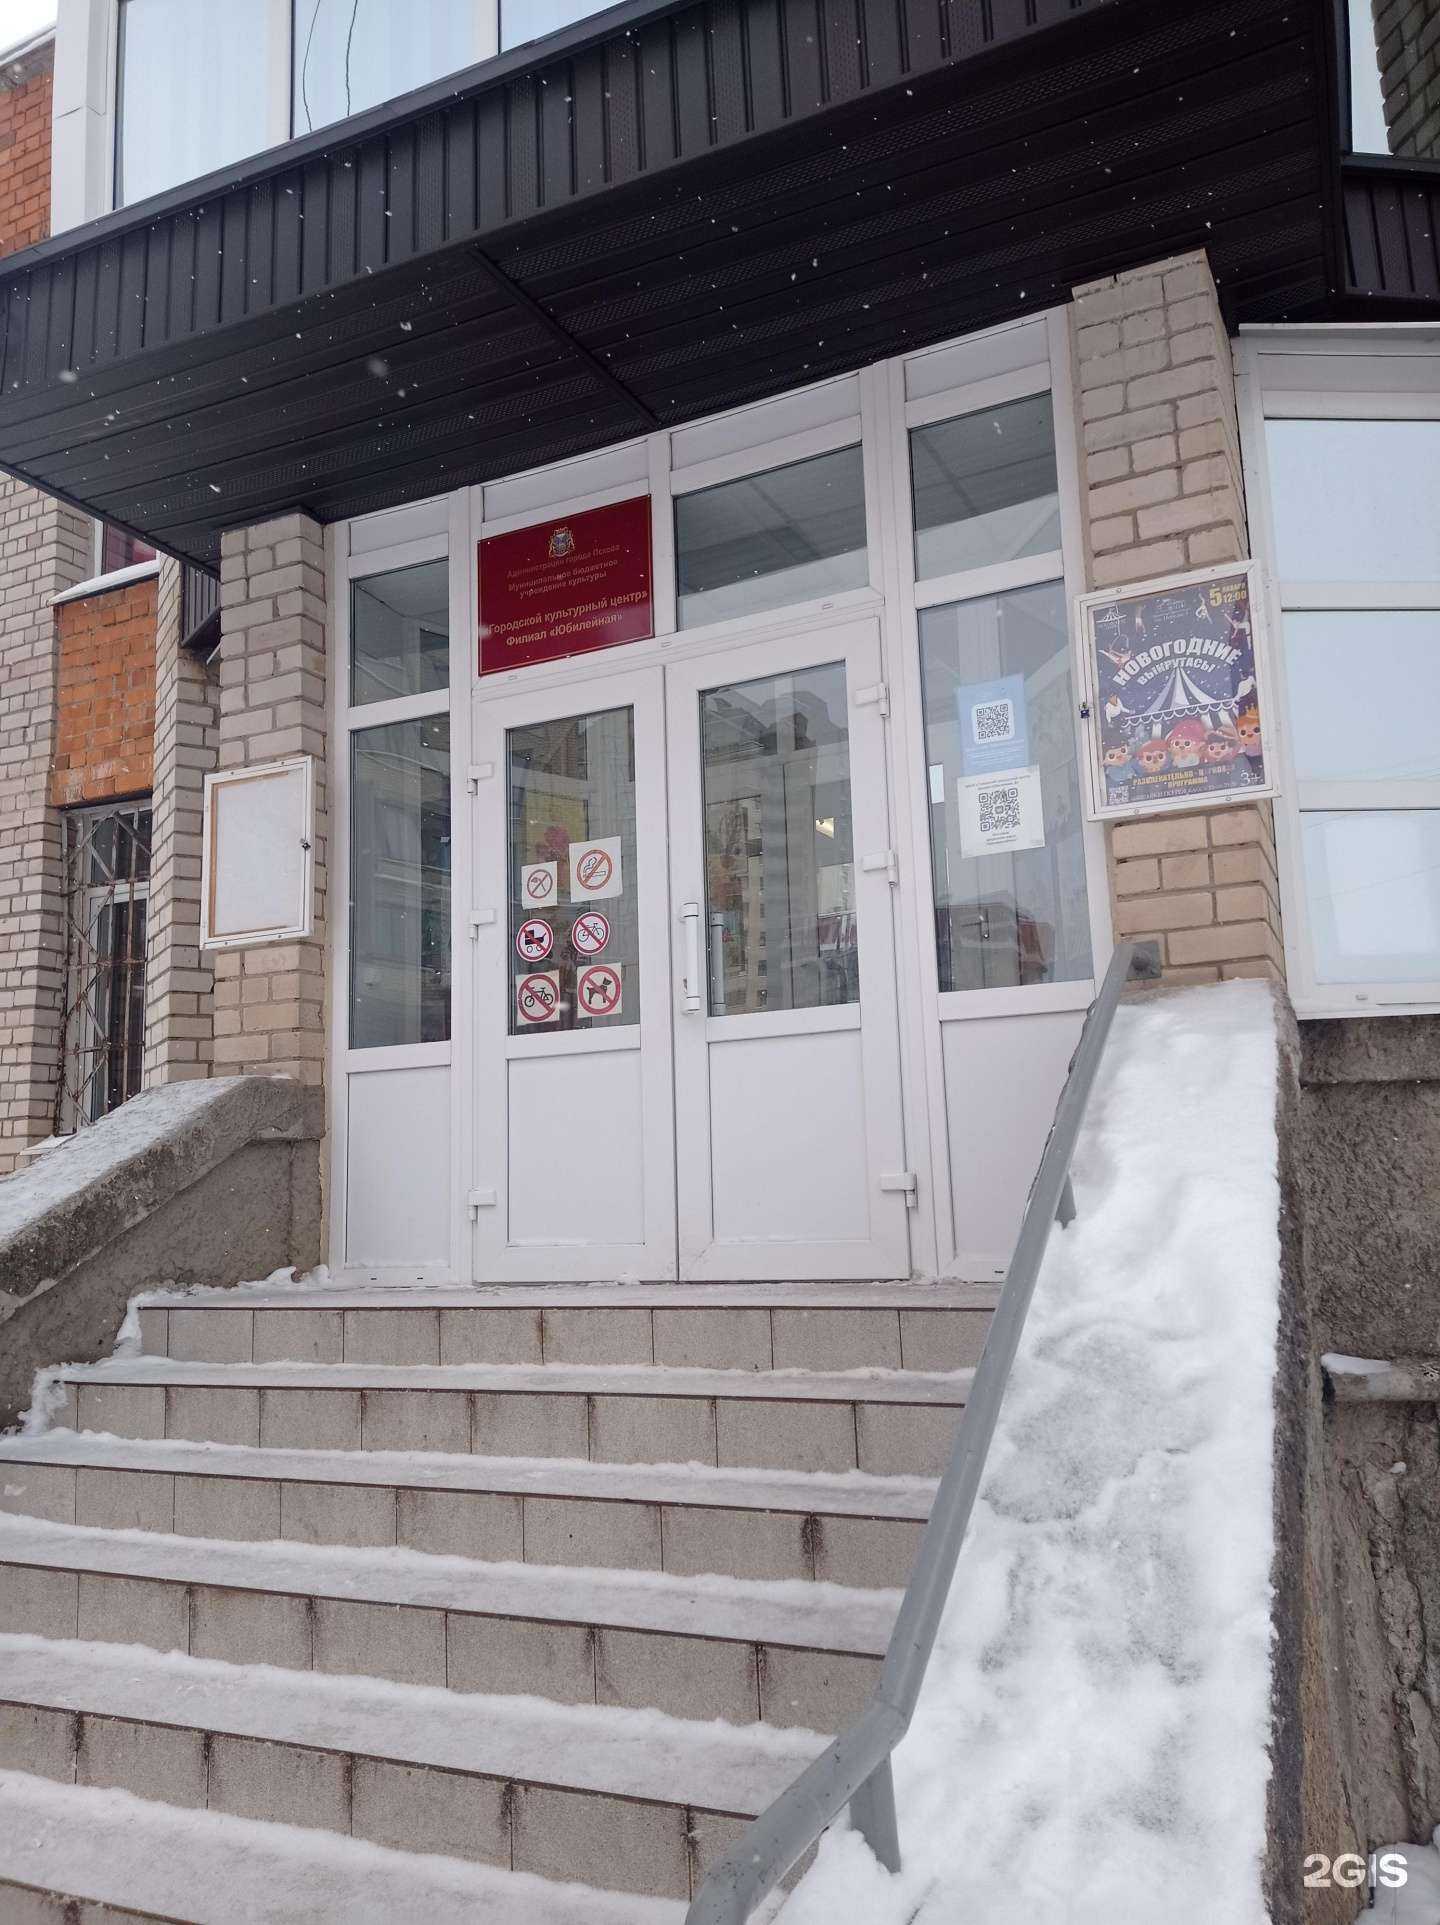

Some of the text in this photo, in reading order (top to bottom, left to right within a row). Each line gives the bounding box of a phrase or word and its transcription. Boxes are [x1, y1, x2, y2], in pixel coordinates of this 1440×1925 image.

[568, 570, 607, 588] культуры
[545, 597, 608, 623] культурный
[610, 590, 648, 607] центр»
[1209, 587, 1222, 607] 5
[1223, 590, 1247, 603] 12:00
[506, 613, 624, 647] Филиал «Юбилейная»
[1112, 637, 1243, 687] НОВОГОДНИЕ
[1137, 657, 1216, 686] ВЫКРУТАСЫ
